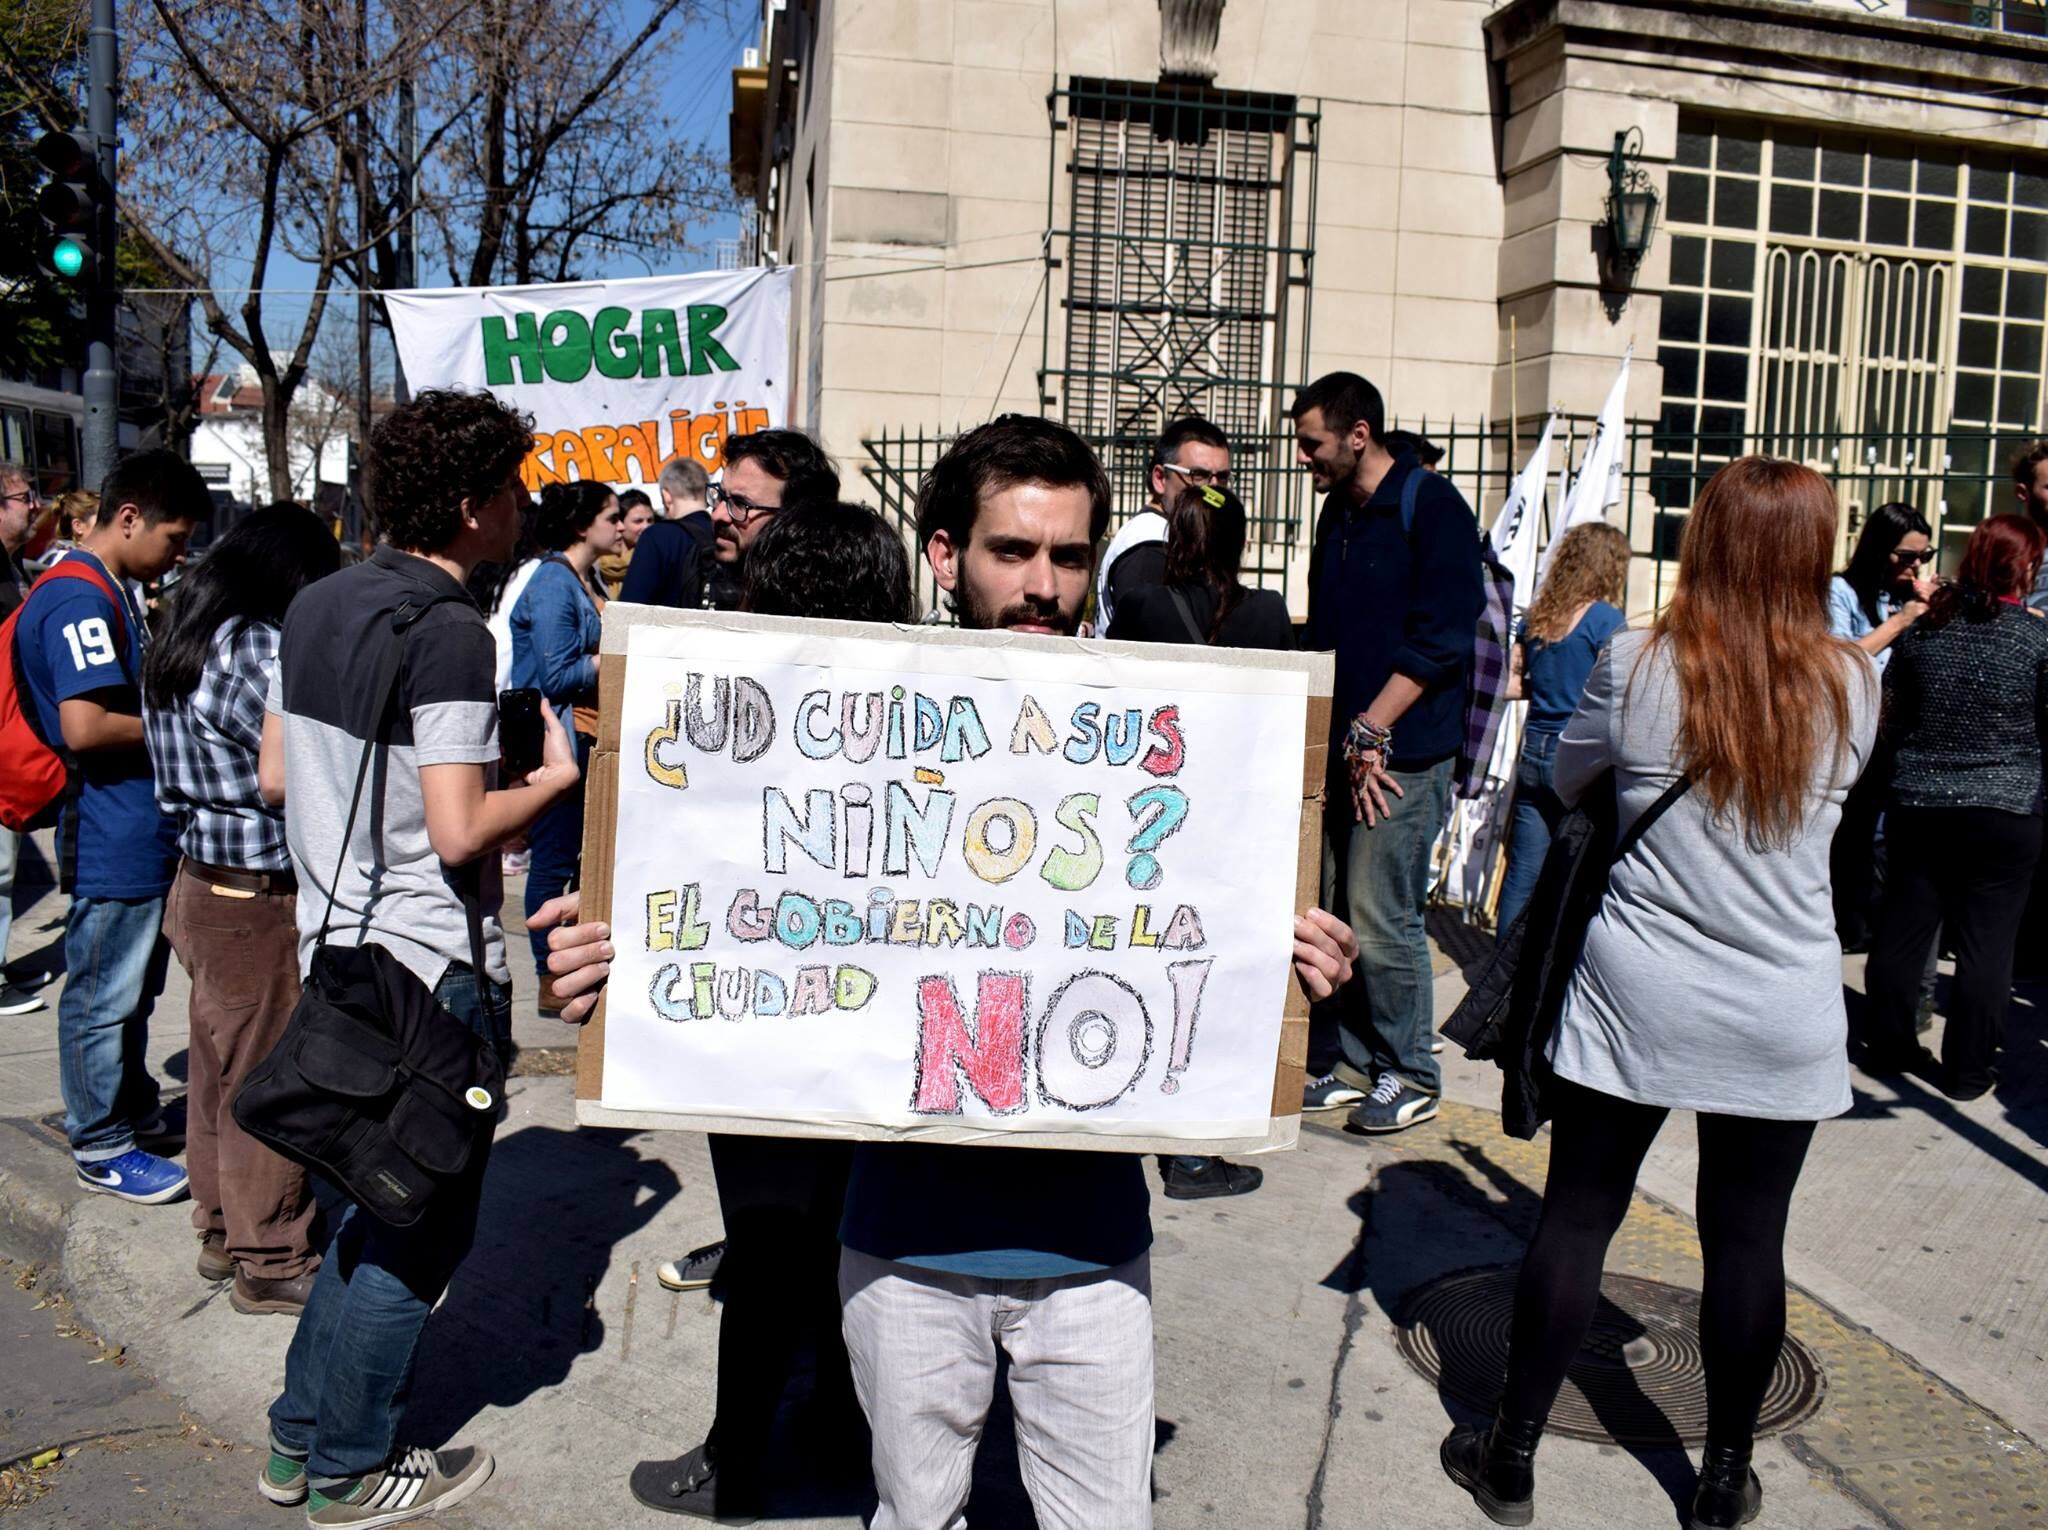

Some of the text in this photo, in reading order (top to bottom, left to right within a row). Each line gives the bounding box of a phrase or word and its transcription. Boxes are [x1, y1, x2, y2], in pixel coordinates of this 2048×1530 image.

[481, 304, 741, 386] HOGAR
[62, 617, 116, 672] 19
[1009, 694, 1059, 755] A
[1062, 701, 1186, 779] SUS
[644, 882, 711, 952] EL
[1064, 908, 1120, 951] DE
[1128, 903, 1209, 953] LA
[908, 955, 1216, 1117] NO!
